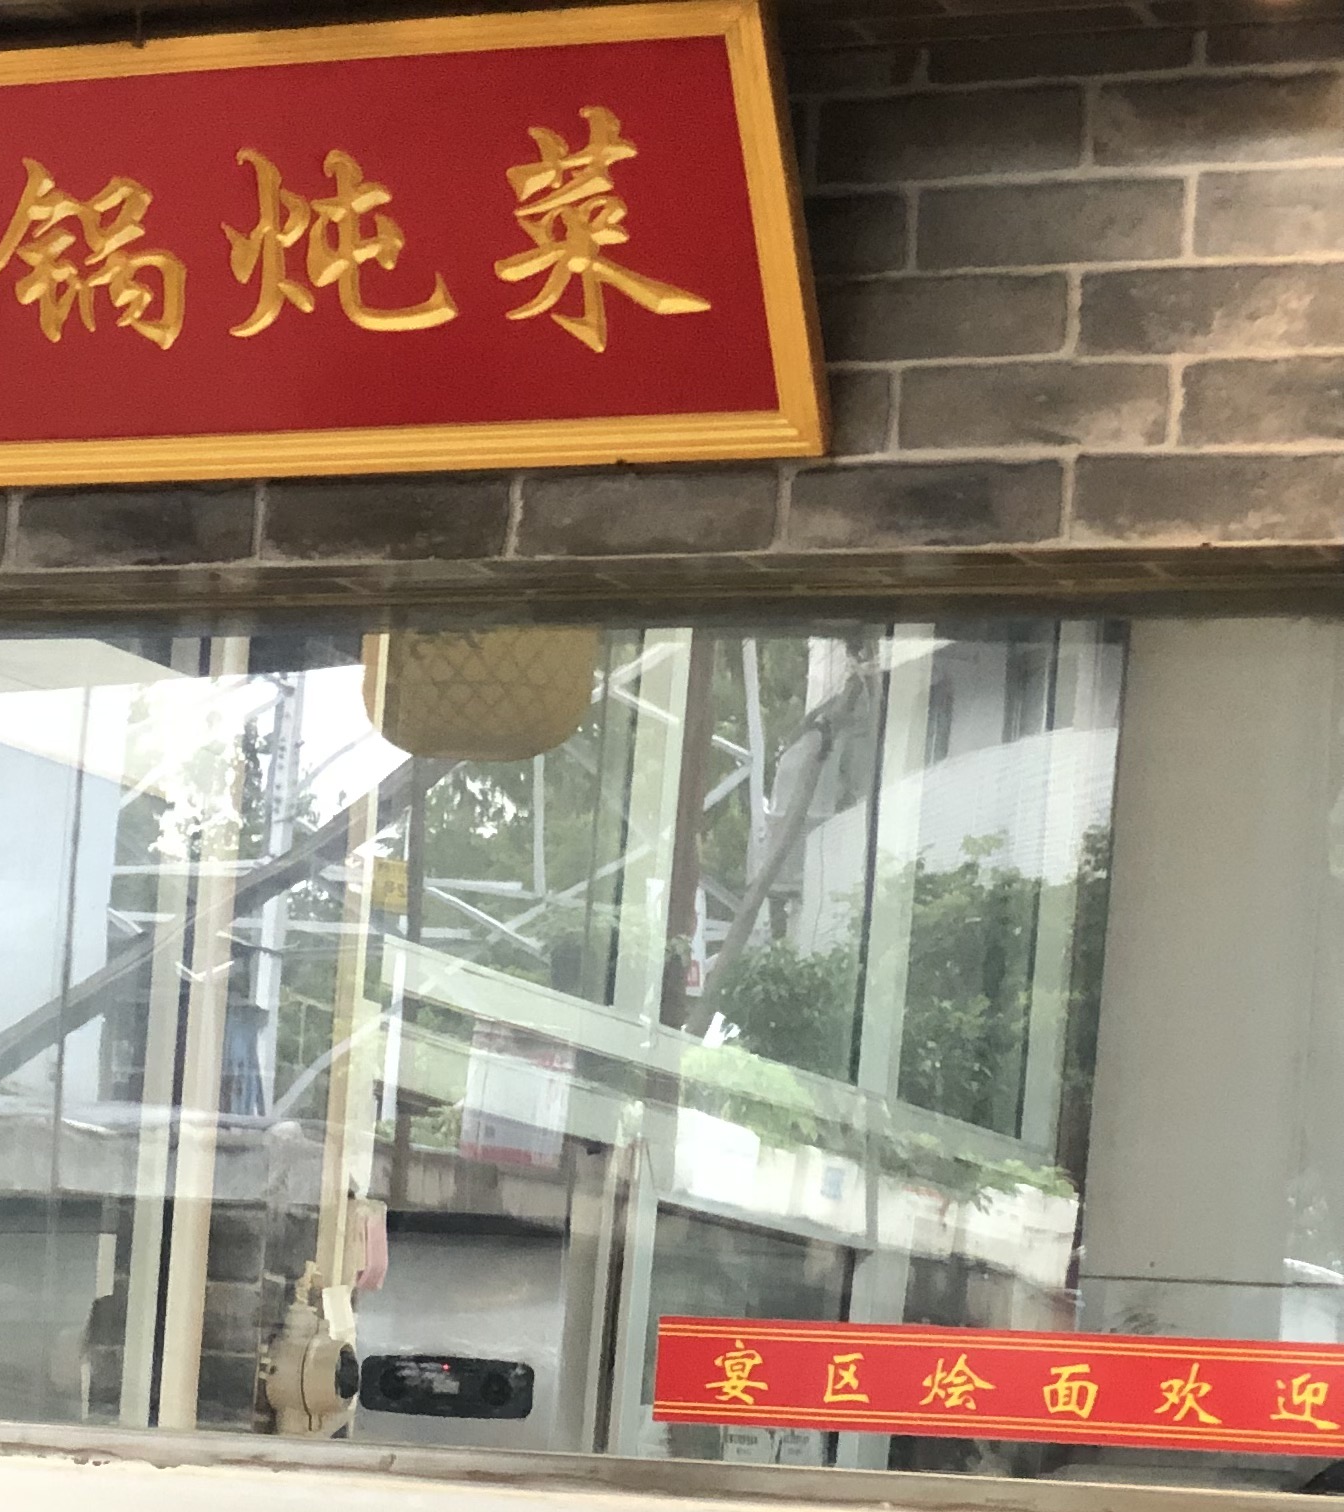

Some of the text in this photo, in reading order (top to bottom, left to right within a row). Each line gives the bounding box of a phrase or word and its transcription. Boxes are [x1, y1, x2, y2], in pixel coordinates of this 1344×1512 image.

[704, 1338, 1342, 1431] 宴区烩面欢迎
